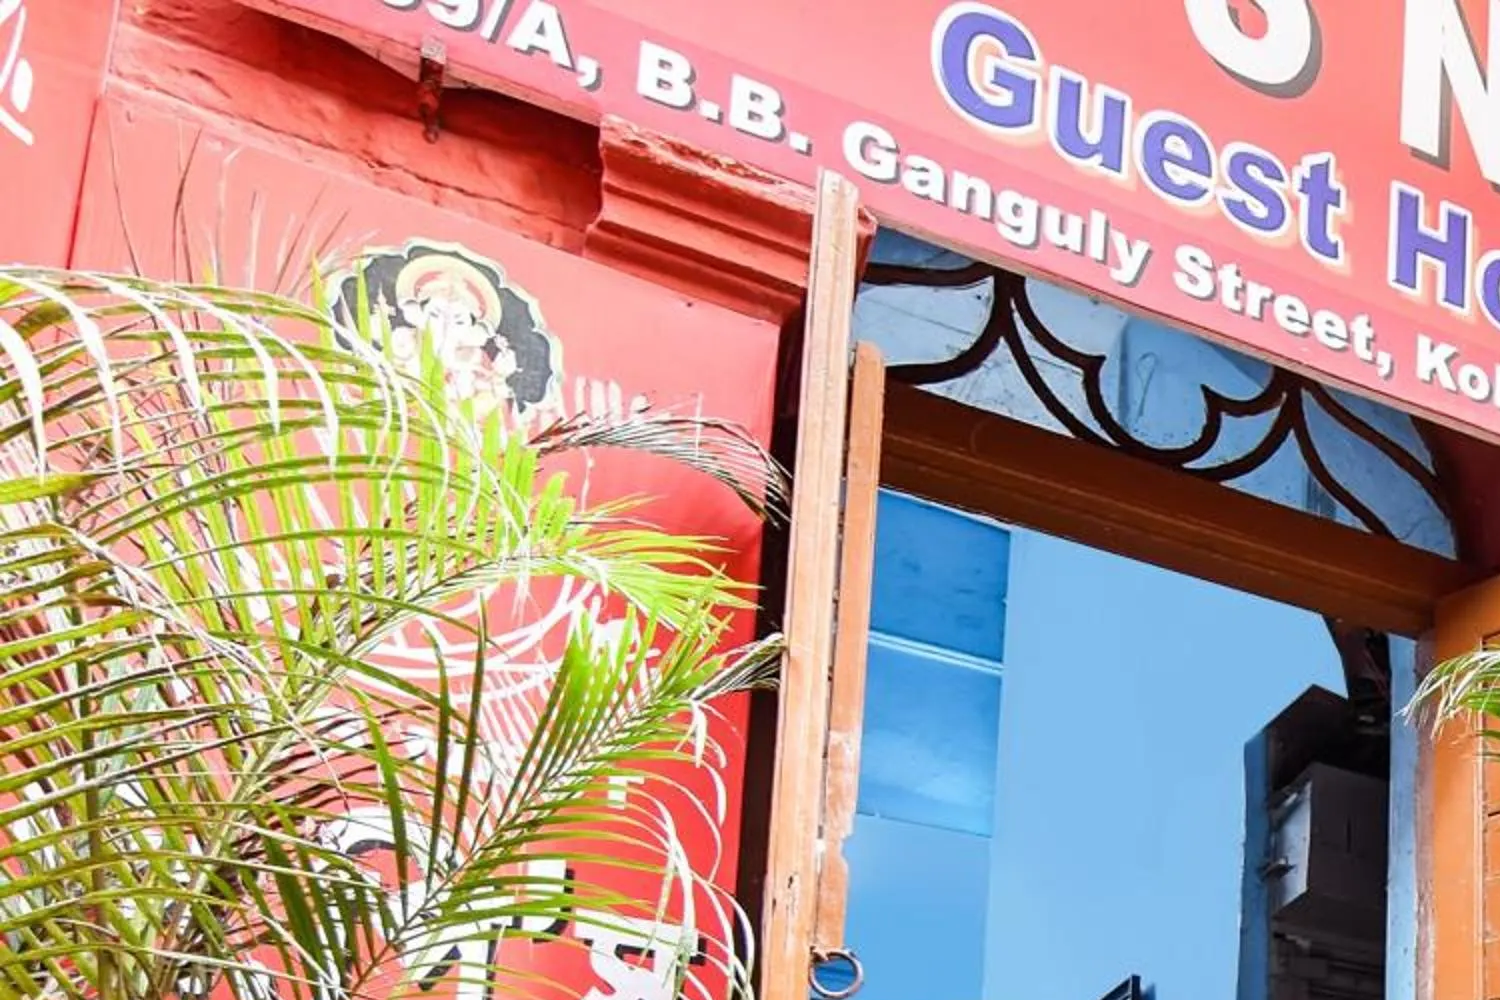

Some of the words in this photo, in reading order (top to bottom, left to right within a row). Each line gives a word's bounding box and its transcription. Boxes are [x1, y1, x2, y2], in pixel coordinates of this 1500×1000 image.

[637, 40, 811, 153] B.B.
[843, 121, 1152, 287] Ganguly
[1173, 244, 1394, 380] Street,
[931, 0, 1350, 268] Guest
